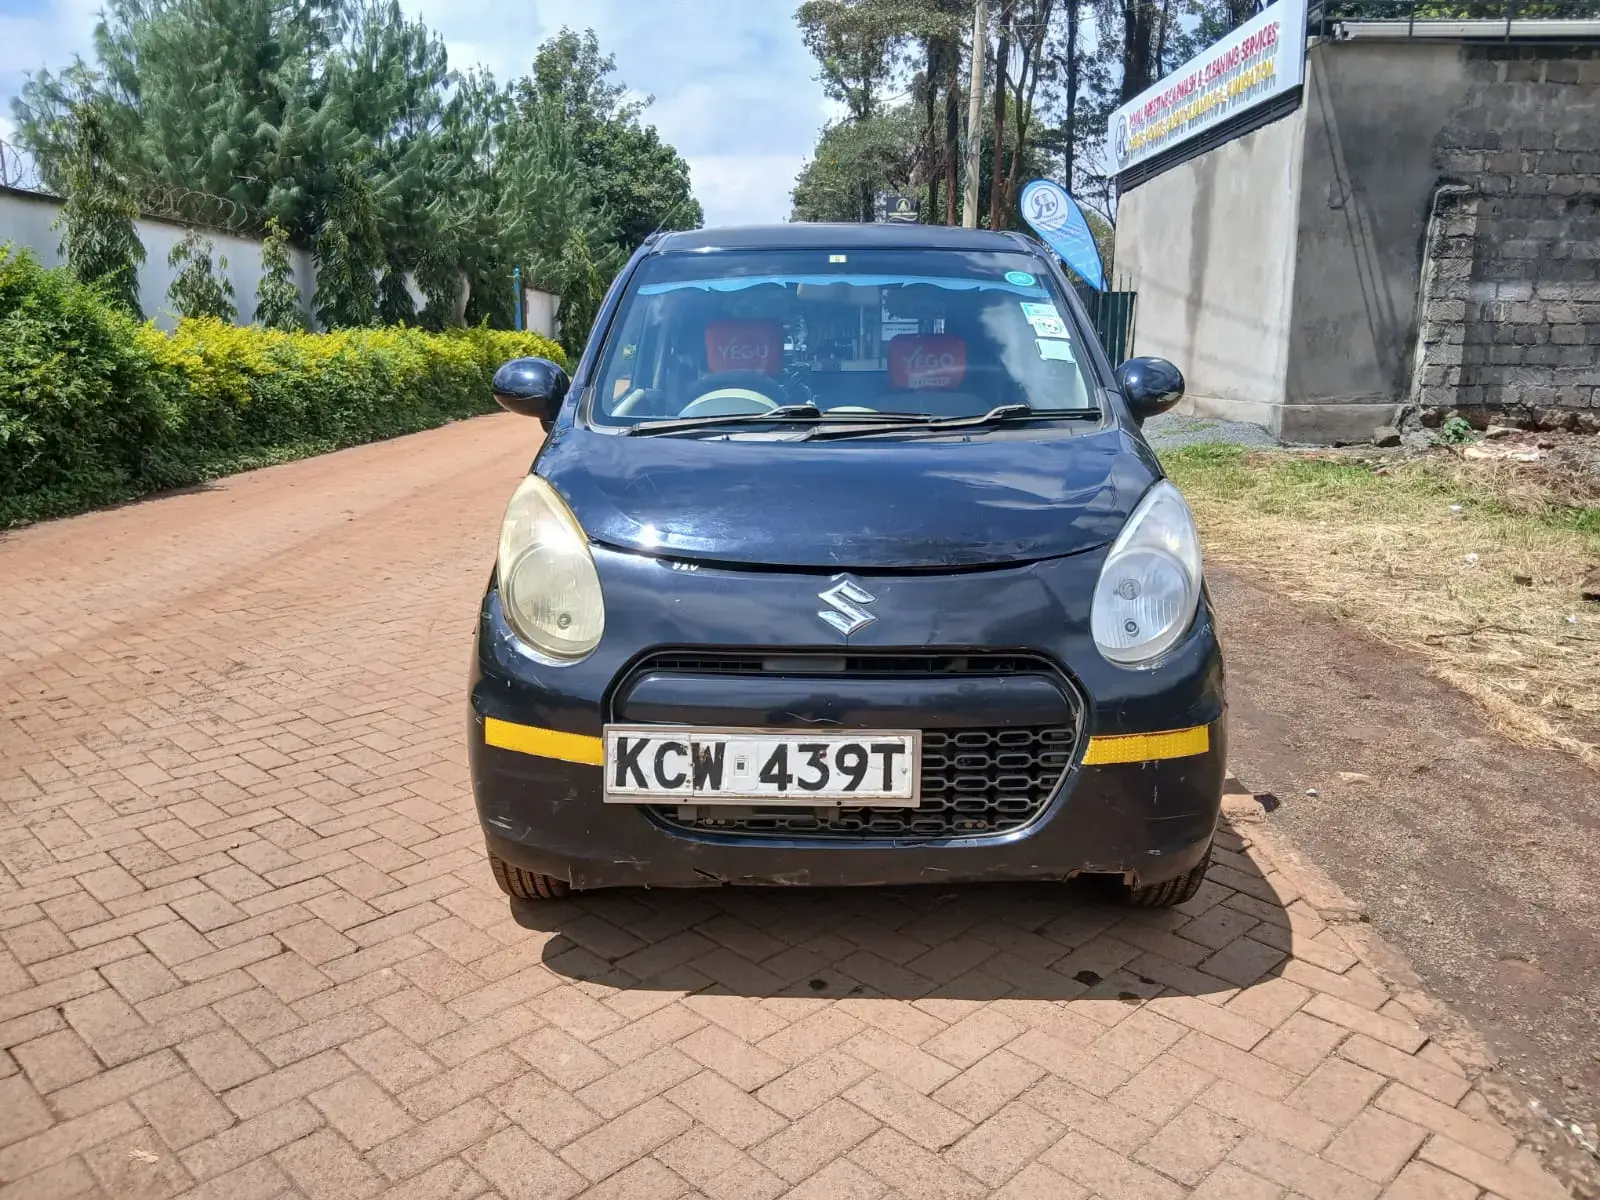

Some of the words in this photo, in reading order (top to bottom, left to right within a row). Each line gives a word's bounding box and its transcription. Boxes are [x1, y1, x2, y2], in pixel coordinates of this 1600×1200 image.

[1204, 45, 1239, 82] CLEANING
[1241, 21, 1276, 61] SERVICES
[902, 345, 955, 369] YEGO
[615, 737, 726, 791] KCW
[759, 742, 906, 792] 439T
